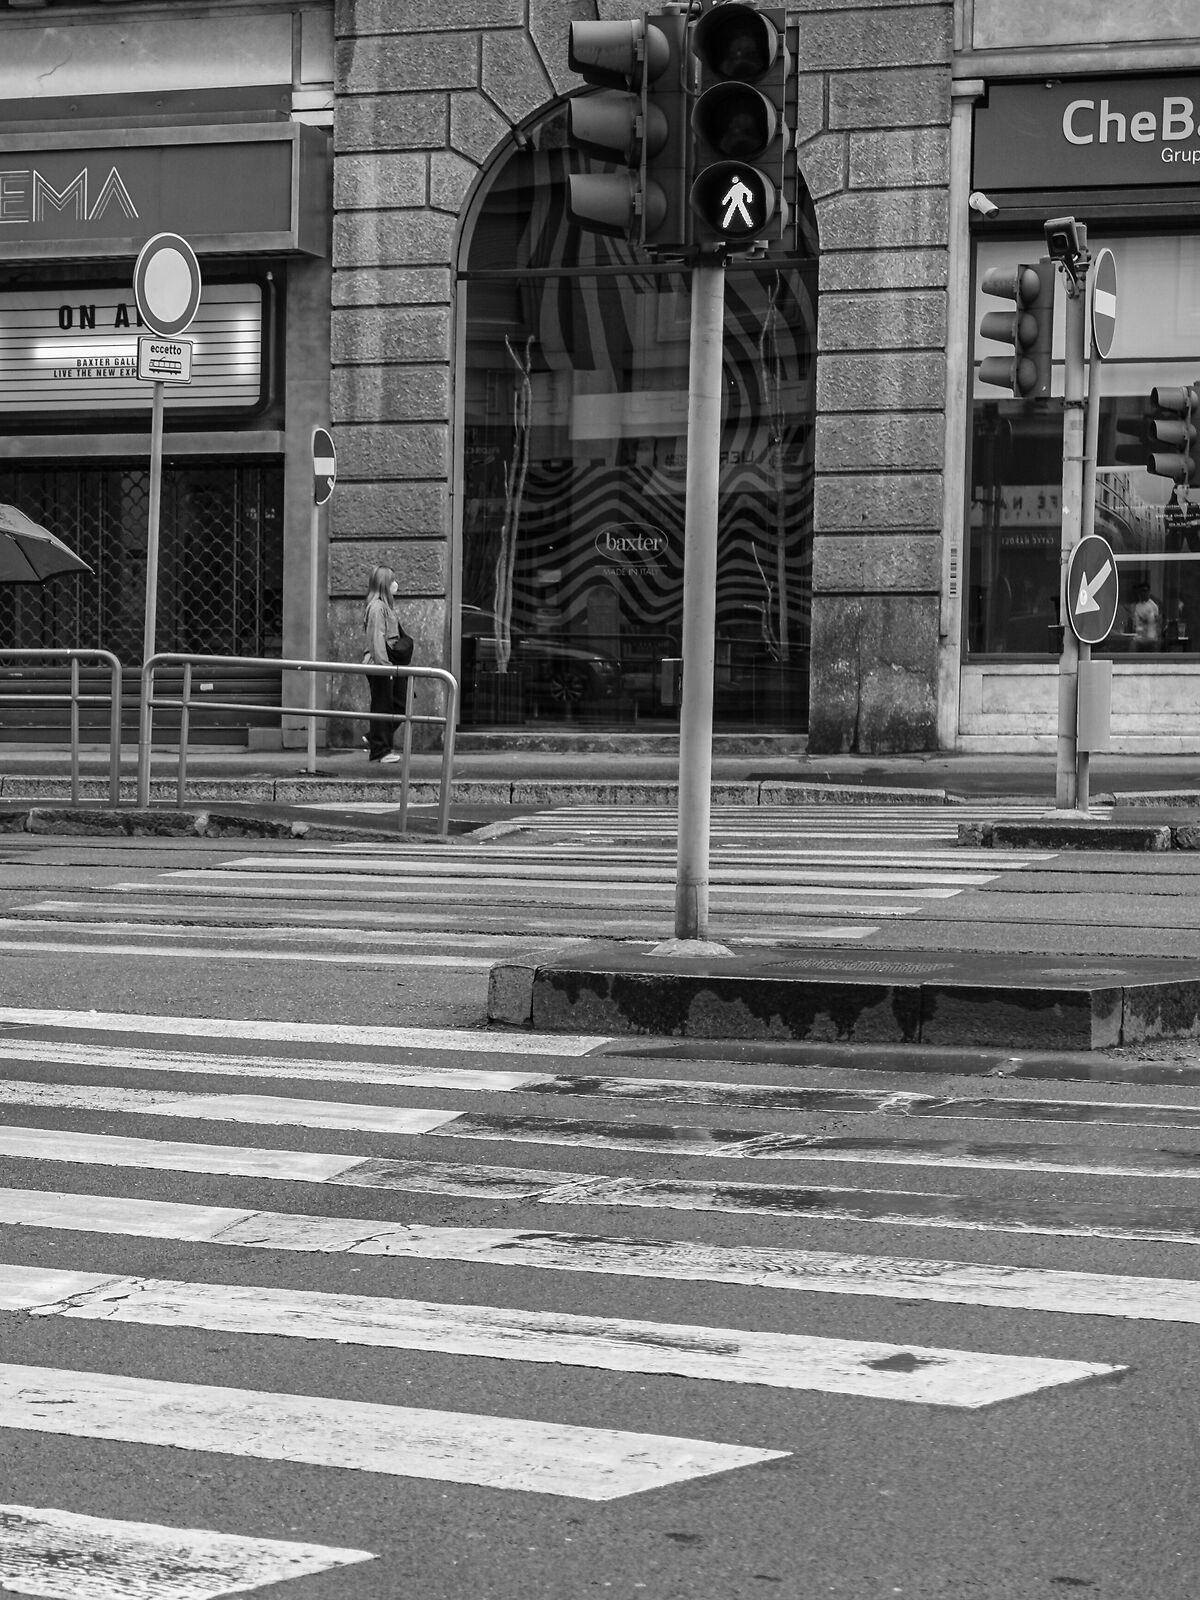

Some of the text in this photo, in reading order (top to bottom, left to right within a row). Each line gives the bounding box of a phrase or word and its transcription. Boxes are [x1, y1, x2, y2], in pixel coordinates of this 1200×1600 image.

[1062, 96, 1200, 145] CheB
[1161, 147, 1200, 165] Grup
[58, 304, 97, 330] ON
[150, 344, 182, 356] eccetto
[76, 356, 136, 367] BAXTER GALL
[53, 366, 137, 378] LIVE THE NEW EXP
[605, 532, 662, 551] baxter
[602, 567, 625, 576] MADE
[628, 567, 638, 576] IN
